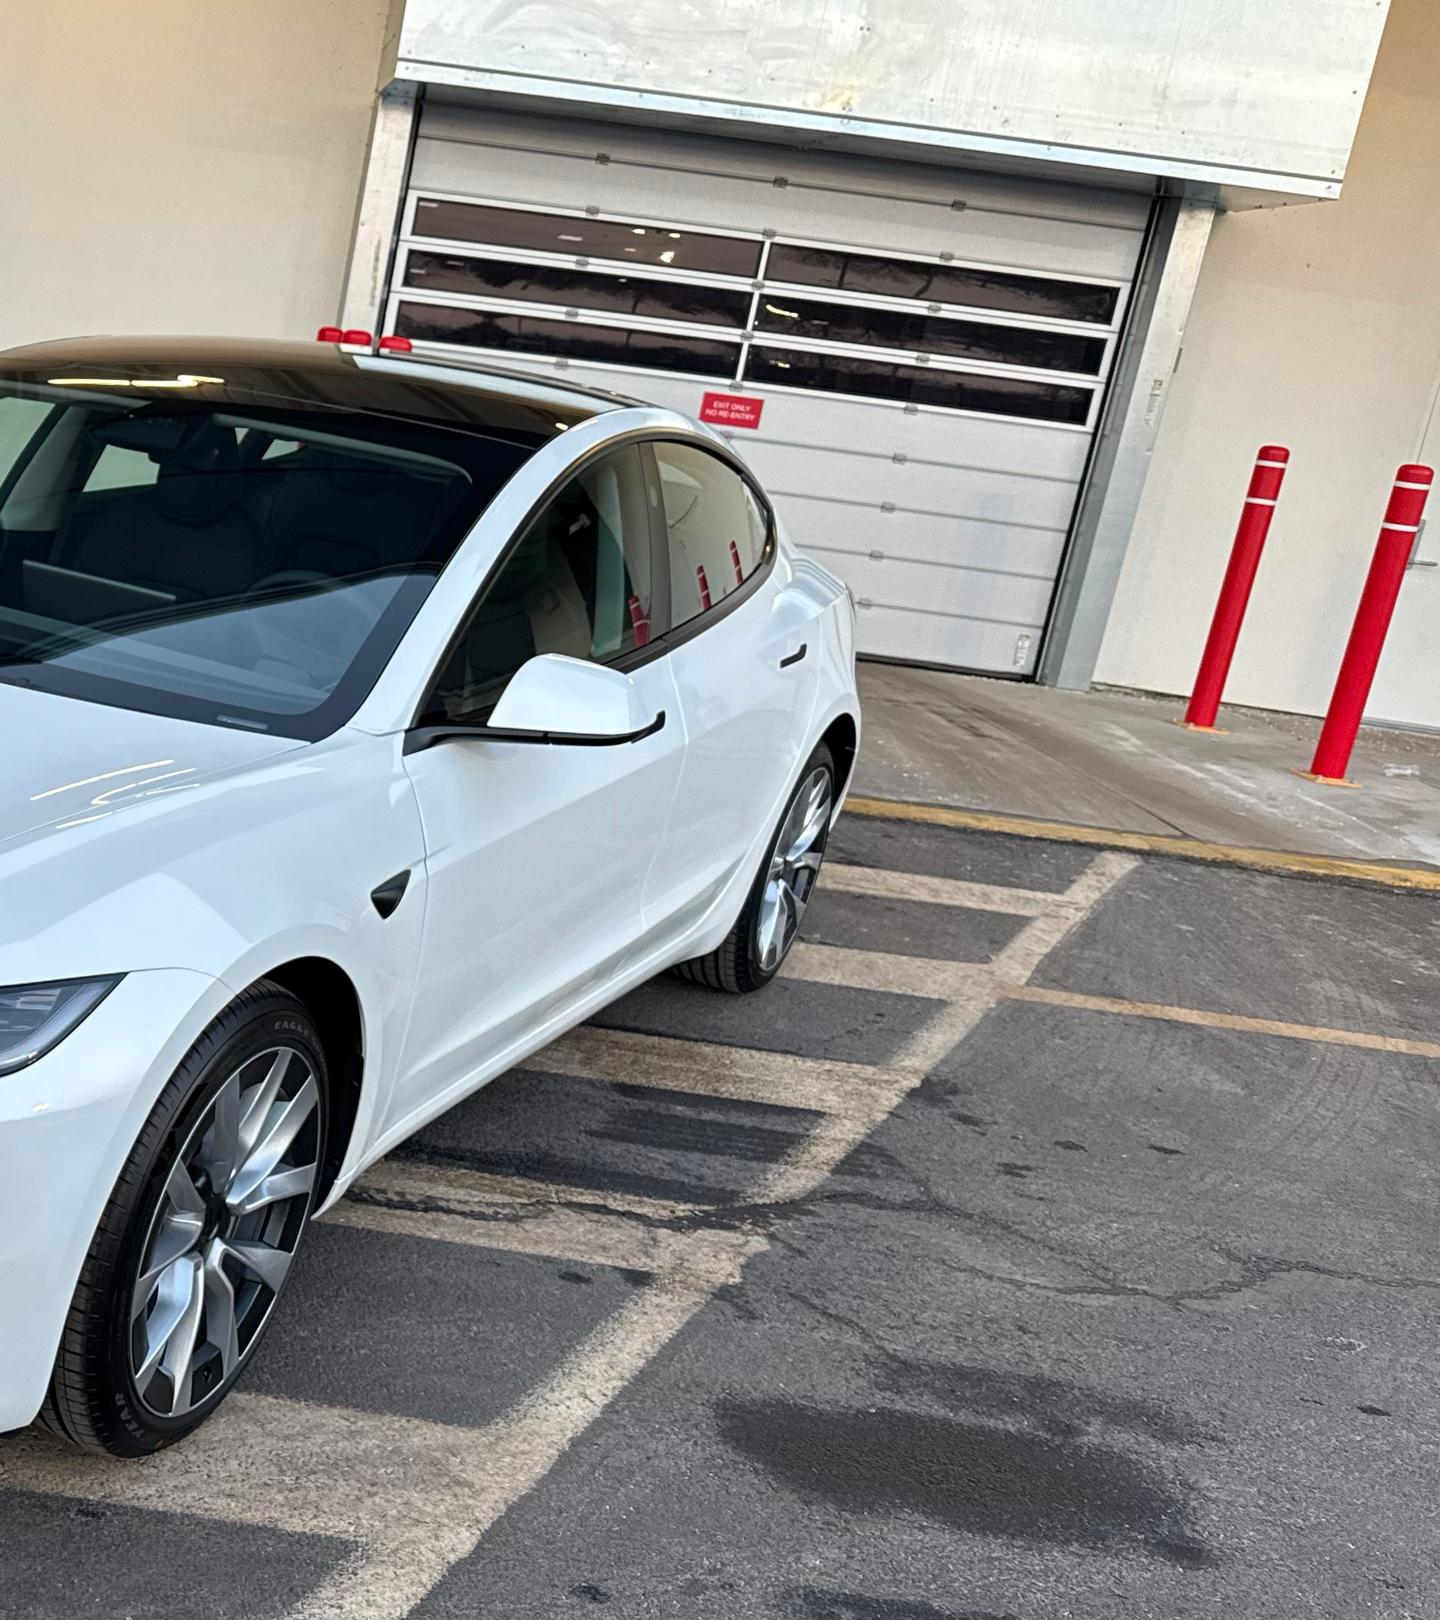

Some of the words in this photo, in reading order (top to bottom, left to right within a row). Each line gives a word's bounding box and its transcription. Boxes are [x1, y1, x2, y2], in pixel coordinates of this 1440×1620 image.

[713, 401, 730, 409] EXIT
[731, 403, 752, 412] ONLY
[705, 408, 718, 417] NO
[718, 410, 756, 421] RE-ENTRY
